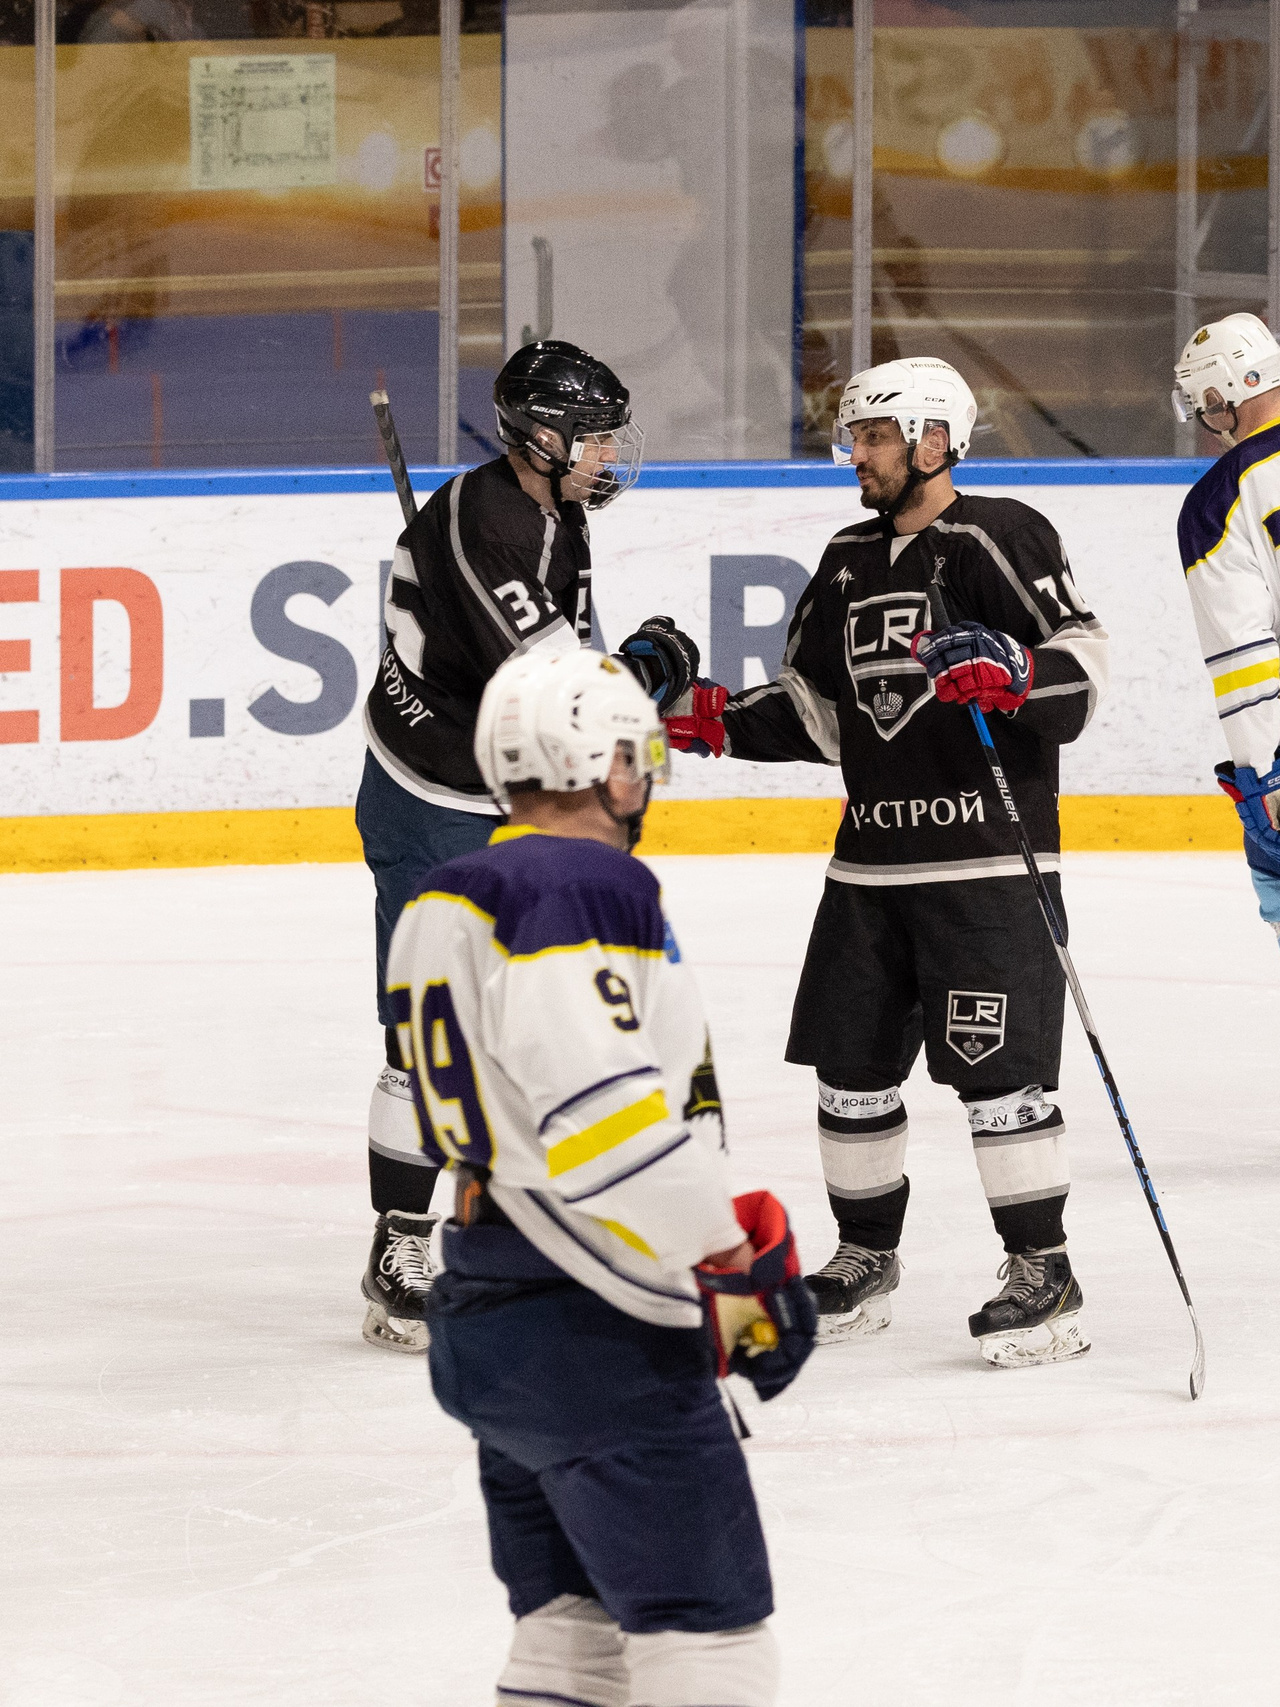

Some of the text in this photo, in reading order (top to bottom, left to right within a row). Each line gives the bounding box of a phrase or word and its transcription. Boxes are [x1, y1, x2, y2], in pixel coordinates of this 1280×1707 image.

[530, 404, 566, 417] BAUER
[524, 440, 552, 462] BAUER
[493, 579, 558, 632] 3
[850, 608, 921, 657] LR
[991, 765, 1019, 823] BAUER
[952, 998, 1000, 1023] LR
